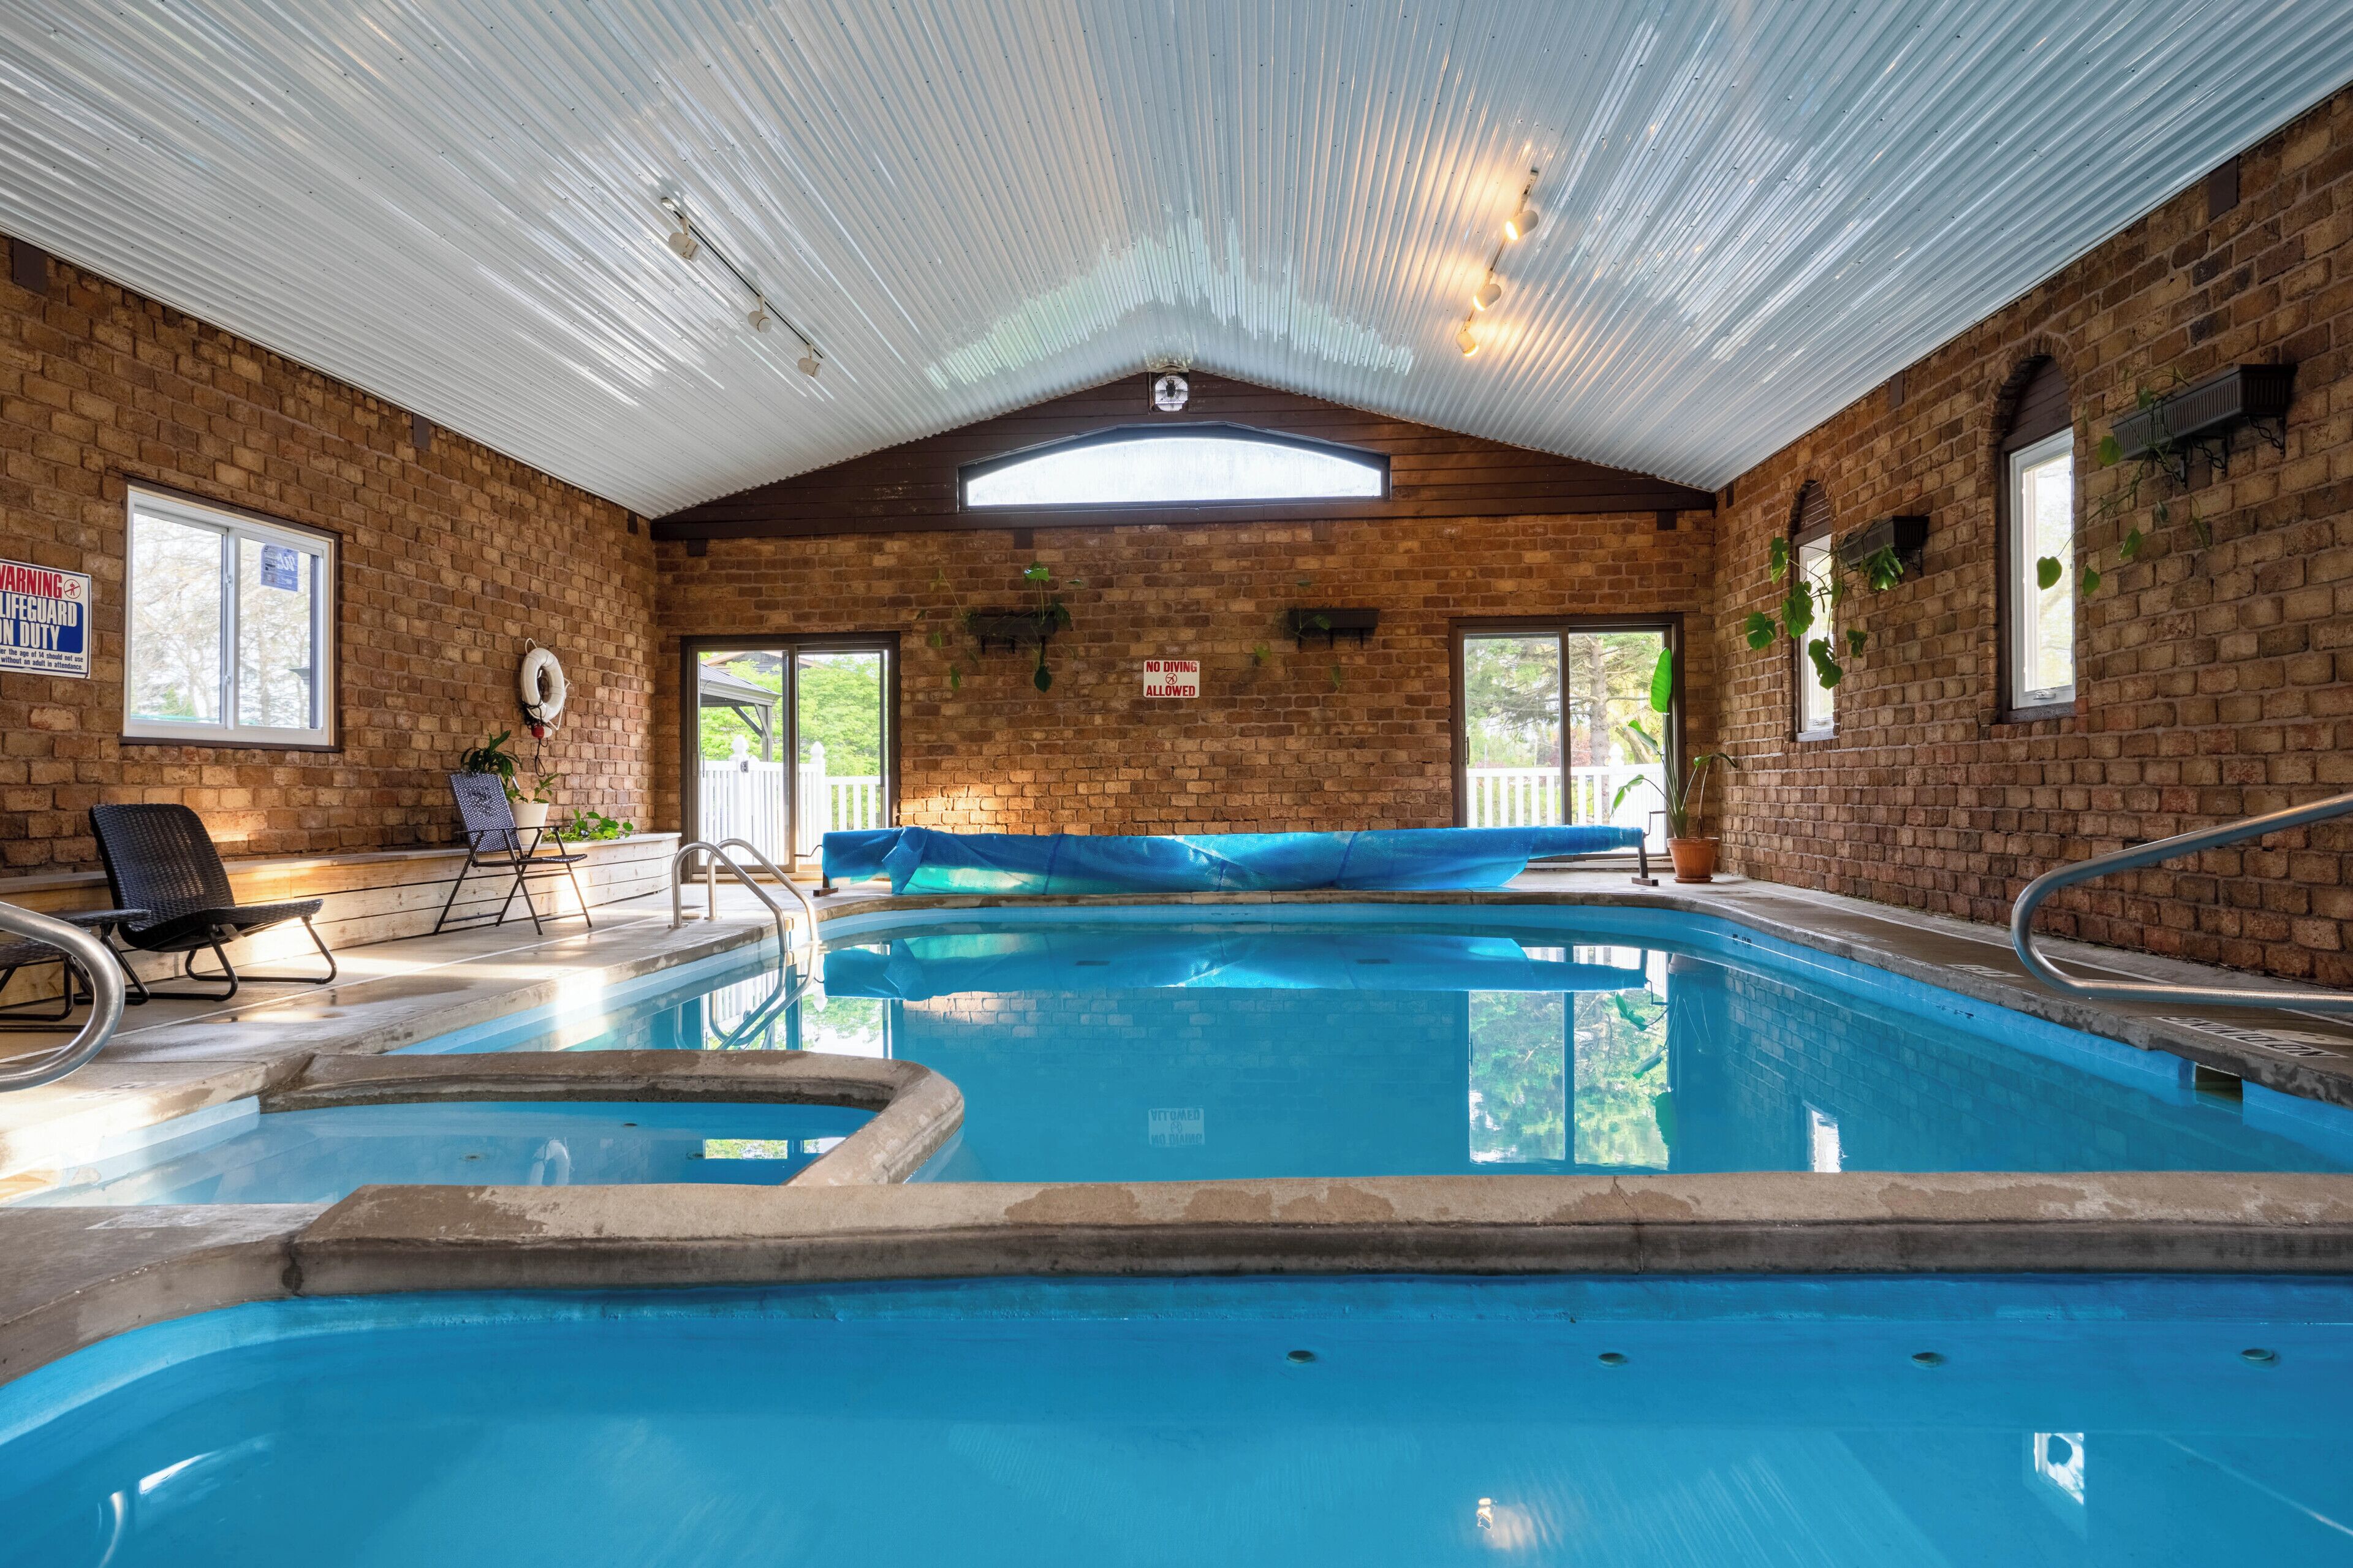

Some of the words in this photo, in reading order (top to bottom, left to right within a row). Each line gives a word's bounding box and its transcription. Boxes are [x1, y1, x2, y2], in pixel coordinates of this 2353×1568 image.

[0, 592, 77, 627] LIFEGUARD
[0, 618, 13, 645] N
[20, 621, 60, 650] DUTY
[55, 661, 83, 670] attendance.
[1146, 661, 1160, 672] NO
[1163, 661, 1197, 672] DIVING
[1146, 685, 1195, 696] ALLOWED
[2162, 1017, 2285, 1042] DIVING
[2264, 1044, 2340, 1056] NO
